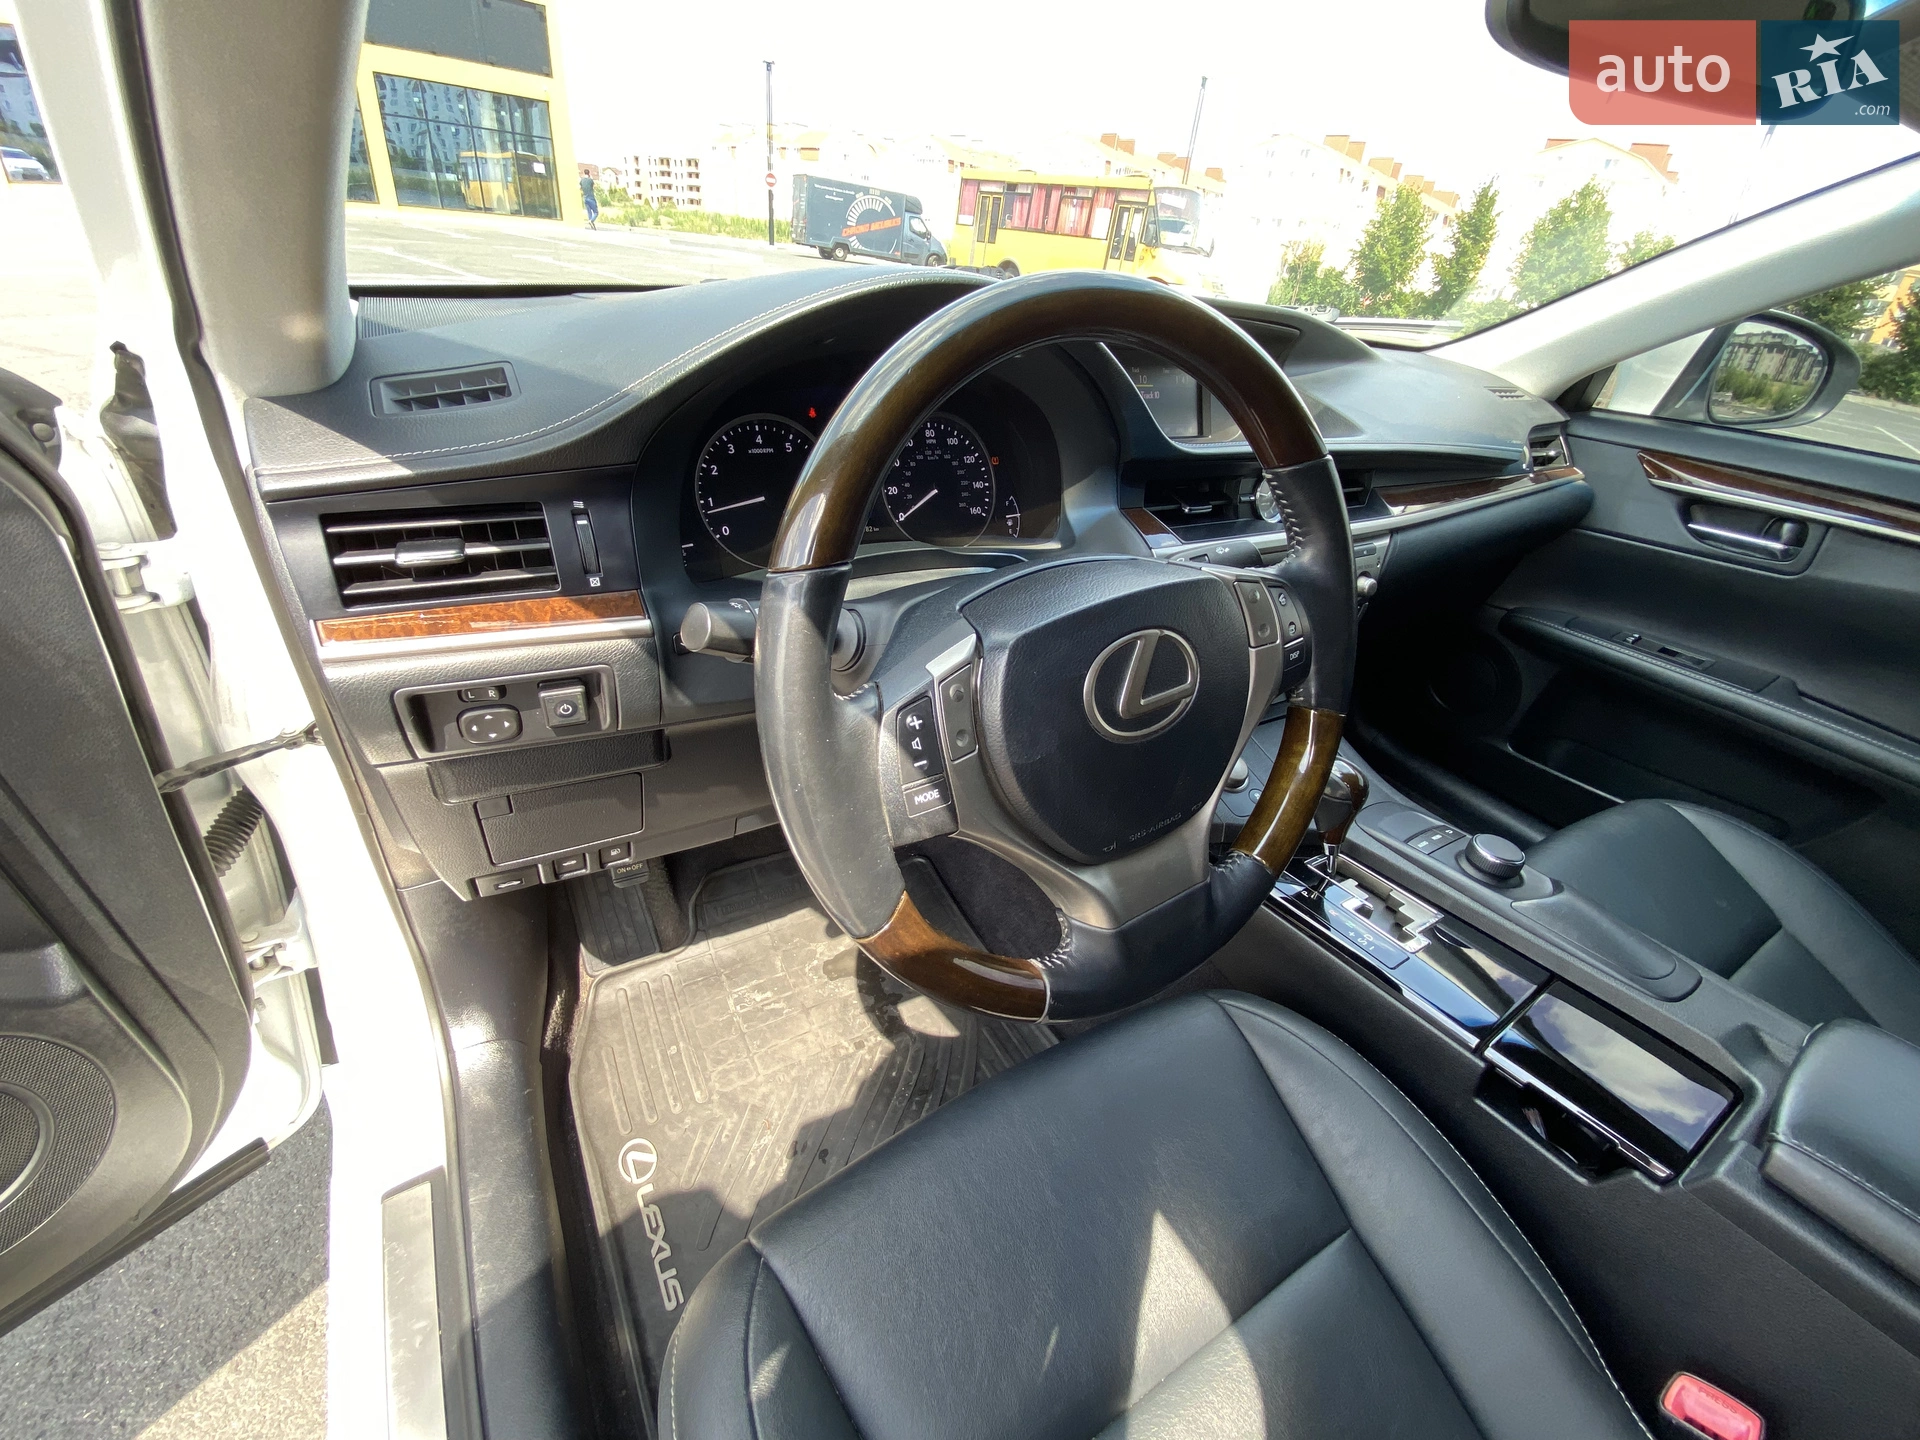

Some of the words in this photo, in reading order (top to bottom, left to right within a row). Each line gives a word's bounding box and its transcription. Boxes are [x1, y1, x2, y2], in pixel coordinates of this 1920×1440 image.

[1139, 375, 1148, 384] 10
[756, 434, 763, 444] 4
[728, 444, 735, 454] 3
[785, 443, 792, 452] 5
[710, 465, 718, 475] 2
[972, 481, 984, 489] 140
[887, 486, 898, 495] 20
[707, 497, 714, 507] 1
[722, 526, 730, 535] 0
[1290, 650, 1300, 660] DISP
[914, 788, 940, 805] MODE
[636, 1182, 684, 1312] LEXUS
[1698, 1386, 1738, 1414] PRESS
